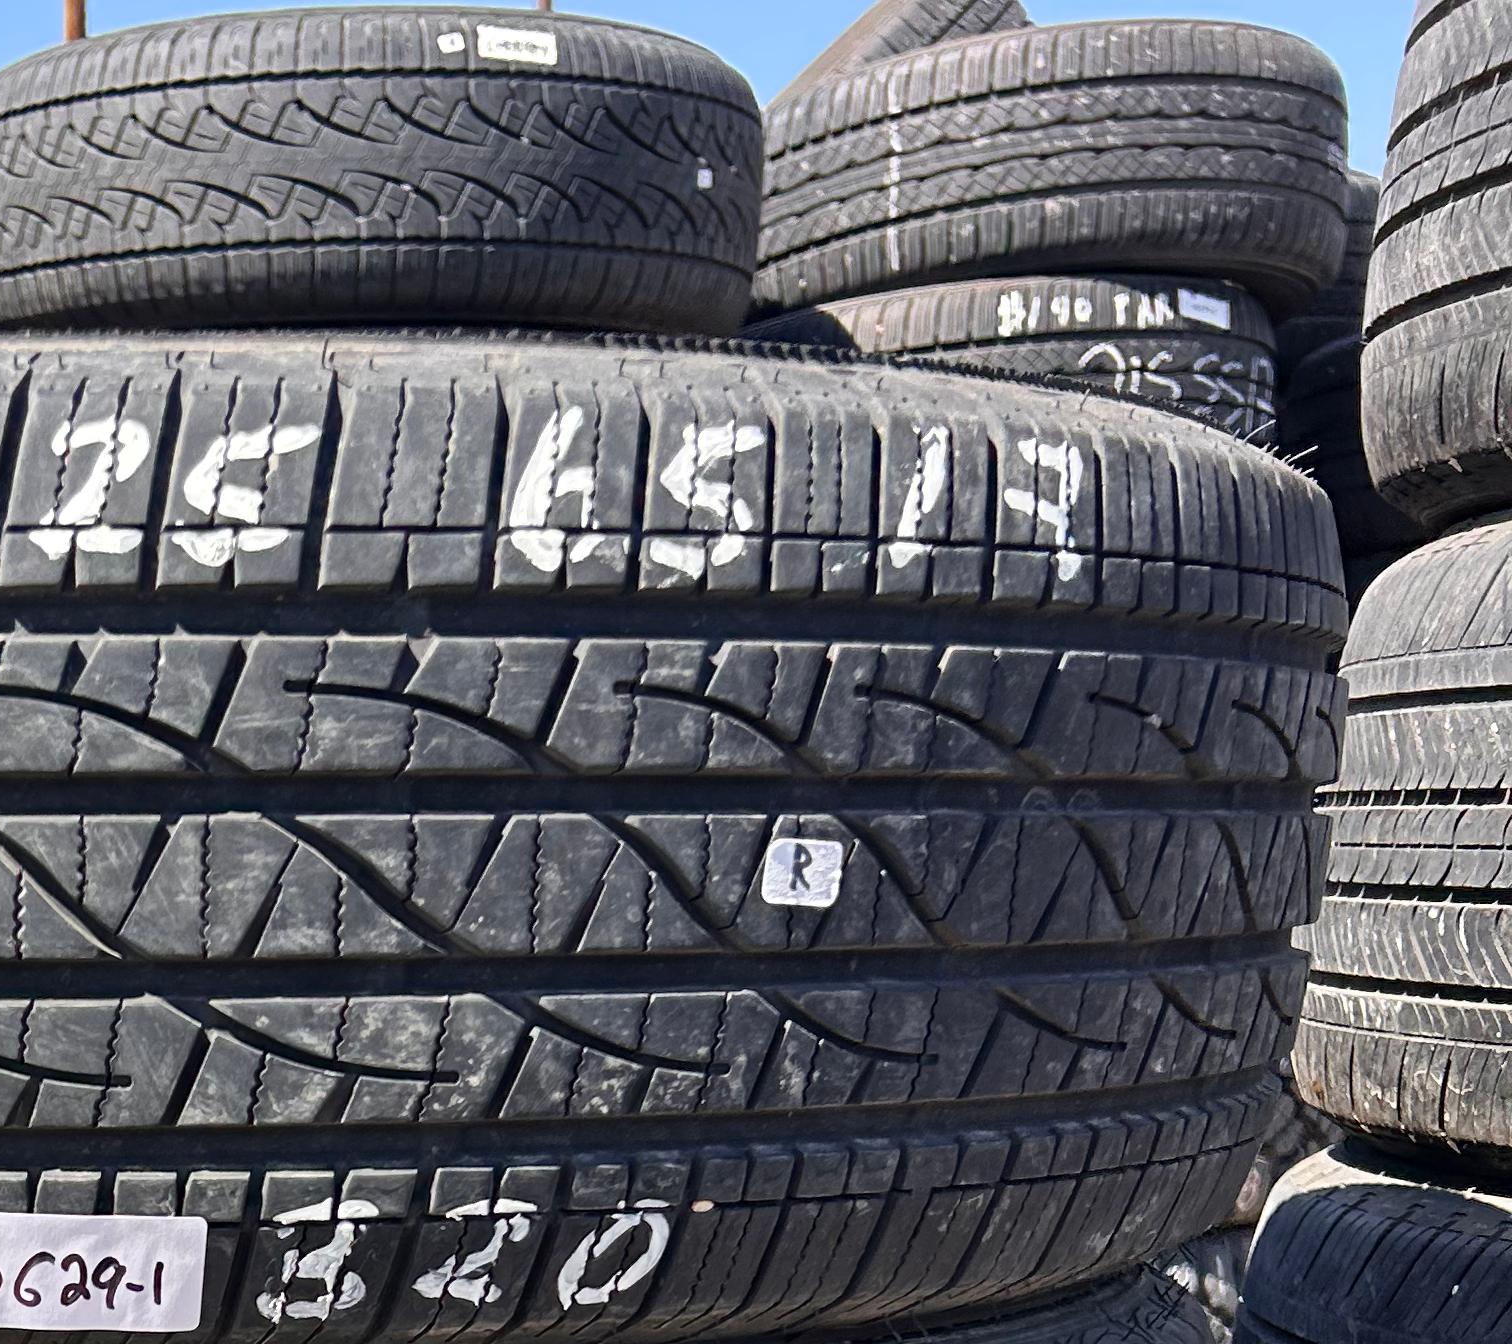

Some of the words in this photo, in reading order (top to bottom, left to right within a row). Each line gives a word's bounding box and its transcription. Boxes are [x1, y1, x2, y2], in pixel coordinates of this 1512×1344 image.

[506, 405, 766, 578] 65
[888, 422, 1084, 583] 17
[790, 842, 813, 890] R
